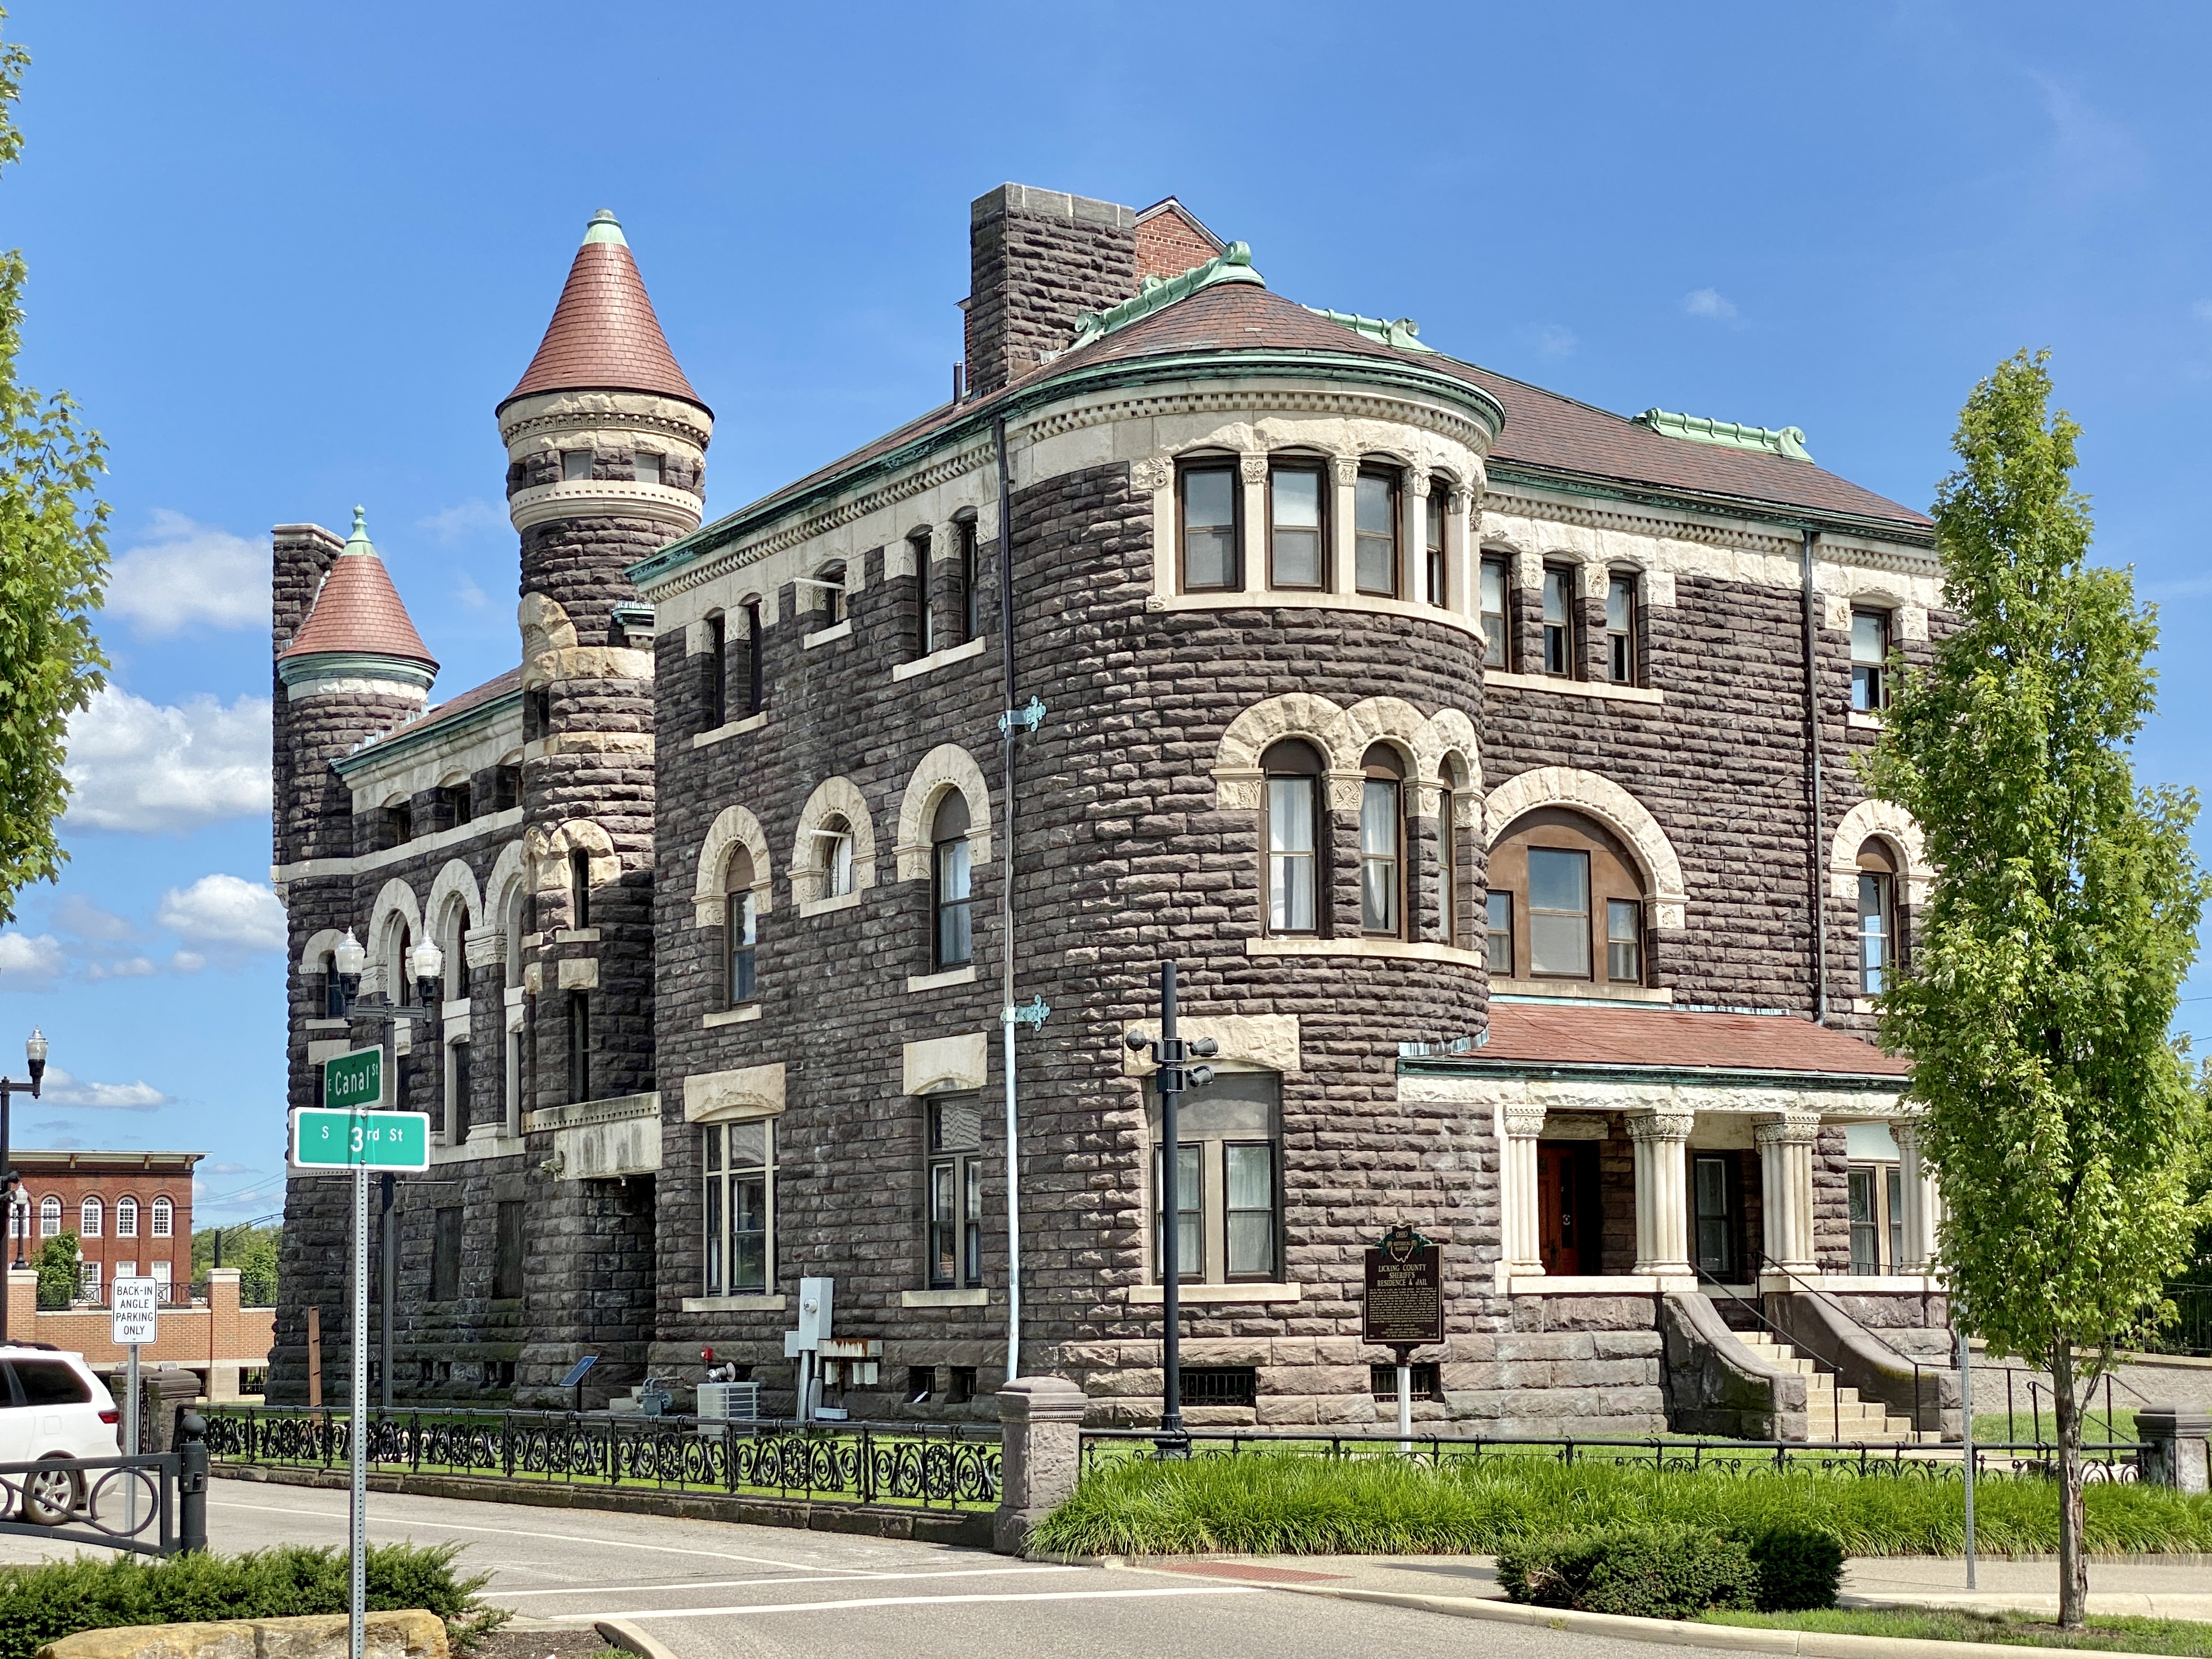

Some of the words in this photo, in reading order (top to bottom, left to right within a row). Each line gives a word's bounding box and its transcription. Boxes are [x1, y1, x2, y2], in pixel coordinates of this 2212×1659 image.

[328, 1079, 331, 1091] E
[336, 1065, 369, 1095] Canal
[372, 1063, 378, 1076] St
[322, 1125, 329, 1139] S
[350, 1127, 379, 1152] 3rd
[389, 1128, 403, 1142] St
[1377, 1279, 1406, 1287] RESIDENCE
[117, 1286, 153, 1296] BACK-IN
[120, 1299, 149, 1309] ANGLE
[116, 1312, 153, 1322] PARKING
[124, 1326, 145, 1335] ONLY
